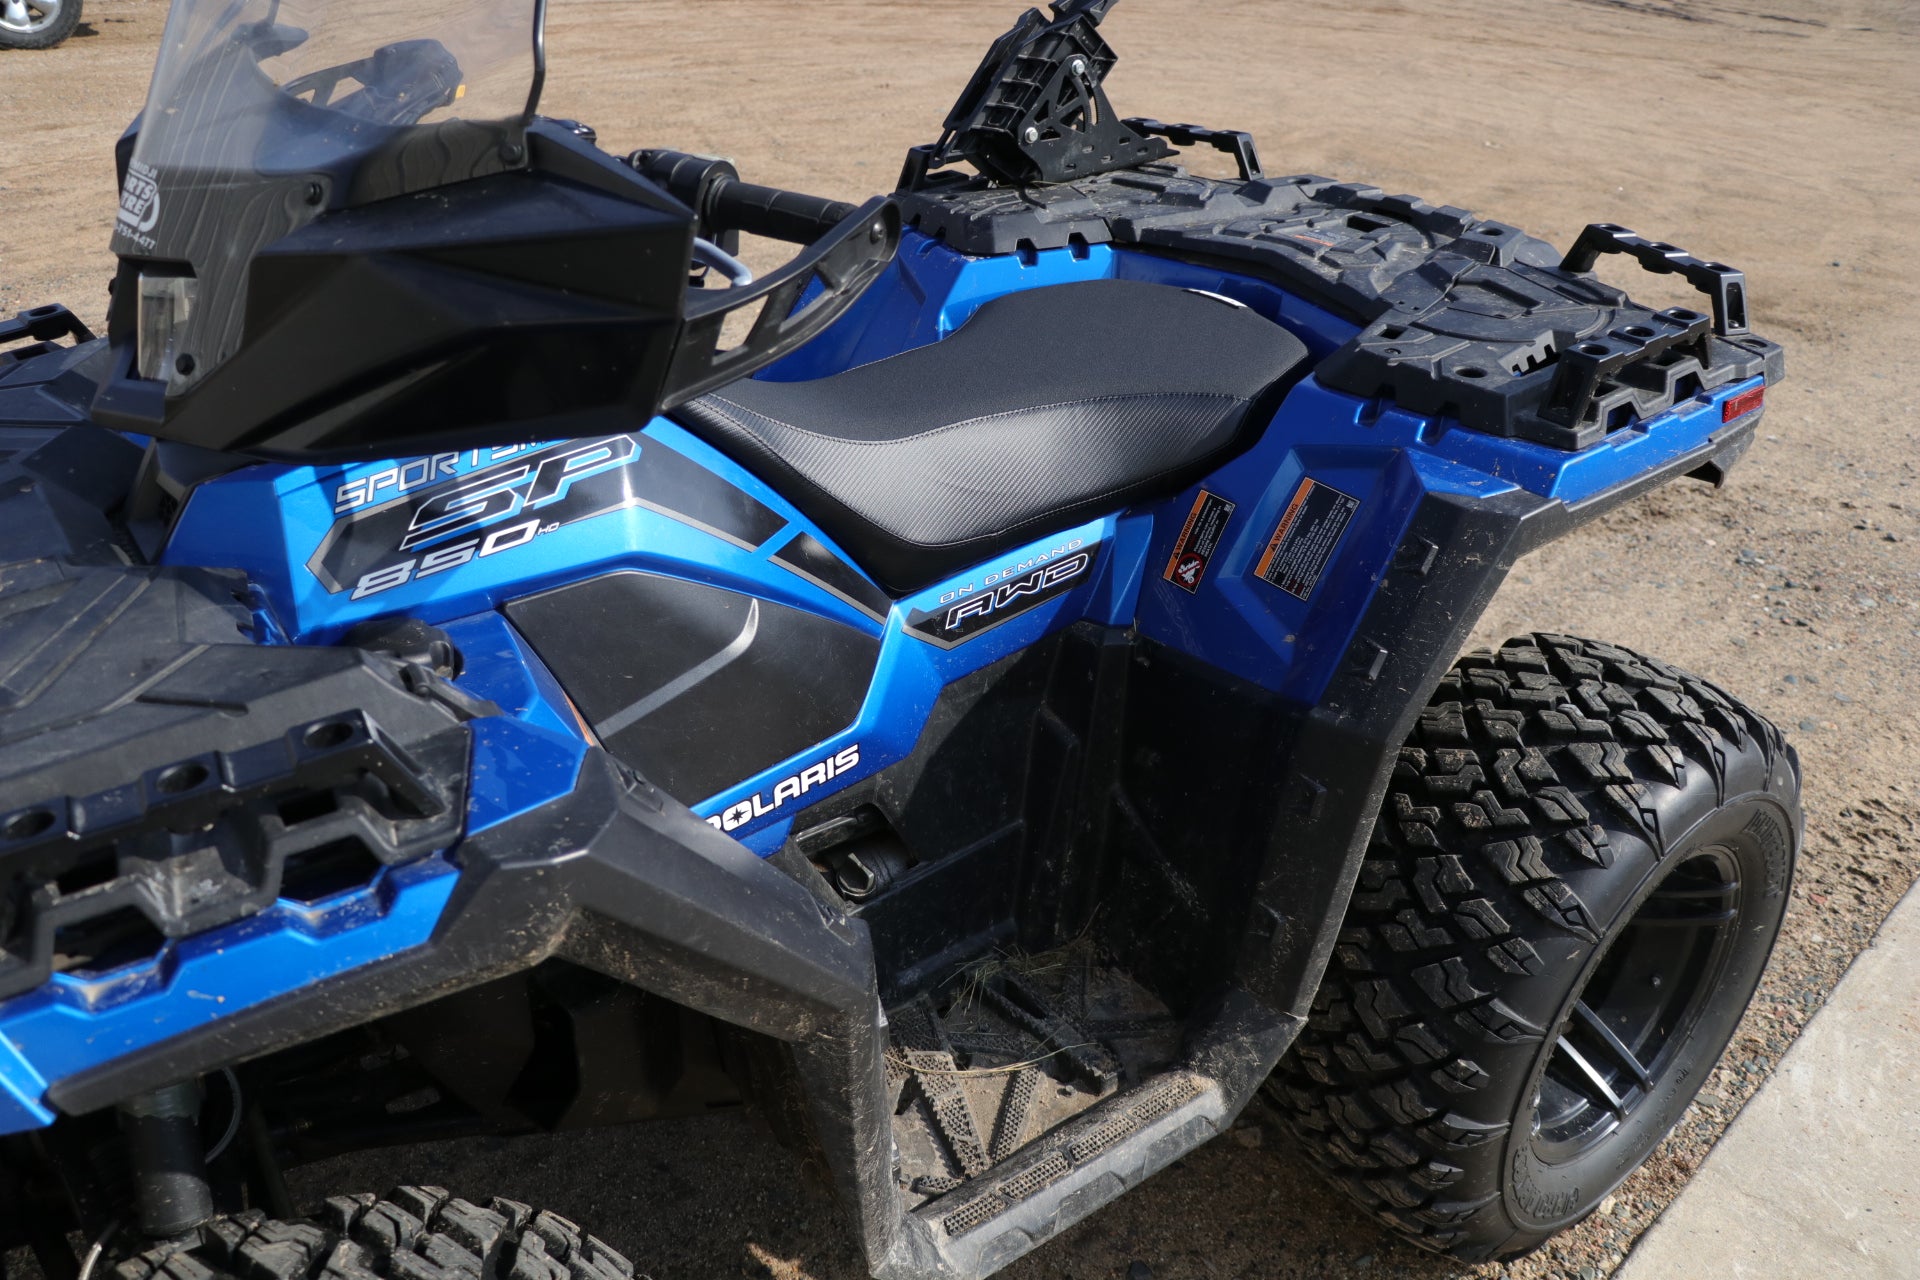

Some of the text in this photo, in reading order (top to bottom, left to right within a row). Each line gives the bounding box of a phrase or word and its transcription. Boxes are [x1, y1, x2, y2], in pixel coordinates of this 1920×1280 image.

[1176, 511, 1197, 551] WARNING
[1274, 503, 1299, 542] WARNING
[350, 519, 541, 601] 850
[939, 538, 1083, 604] ON DEMAND
[945, 553, 1089, 630] AWD
